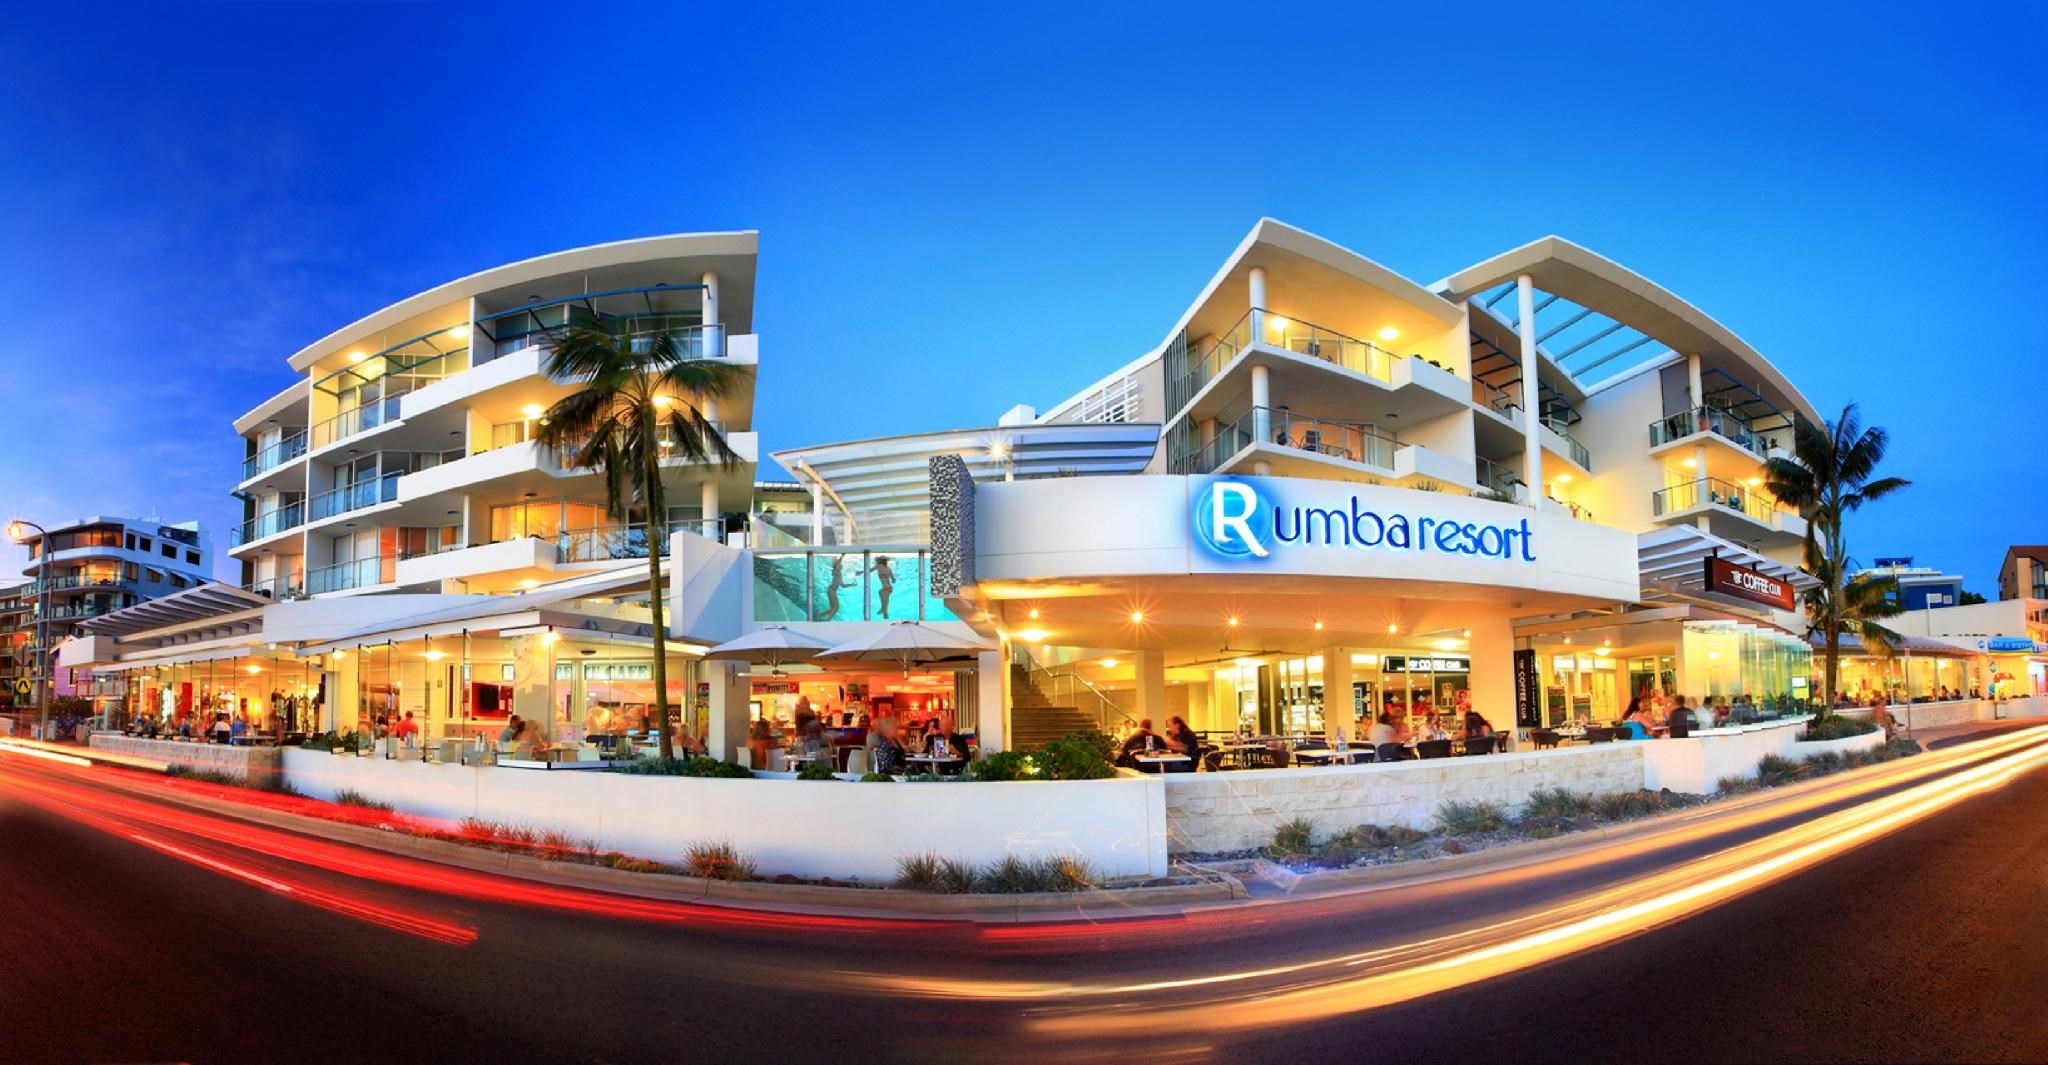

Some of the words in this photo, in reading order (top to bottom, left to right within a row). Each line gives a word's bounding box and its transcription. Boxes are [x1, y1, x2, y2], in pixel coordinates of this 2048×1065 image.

[1213, 482, 1410, 557] Rumba
[1419, 508, 1537, 562] resort
[1743, 573, 1769, 594] COFFEE
